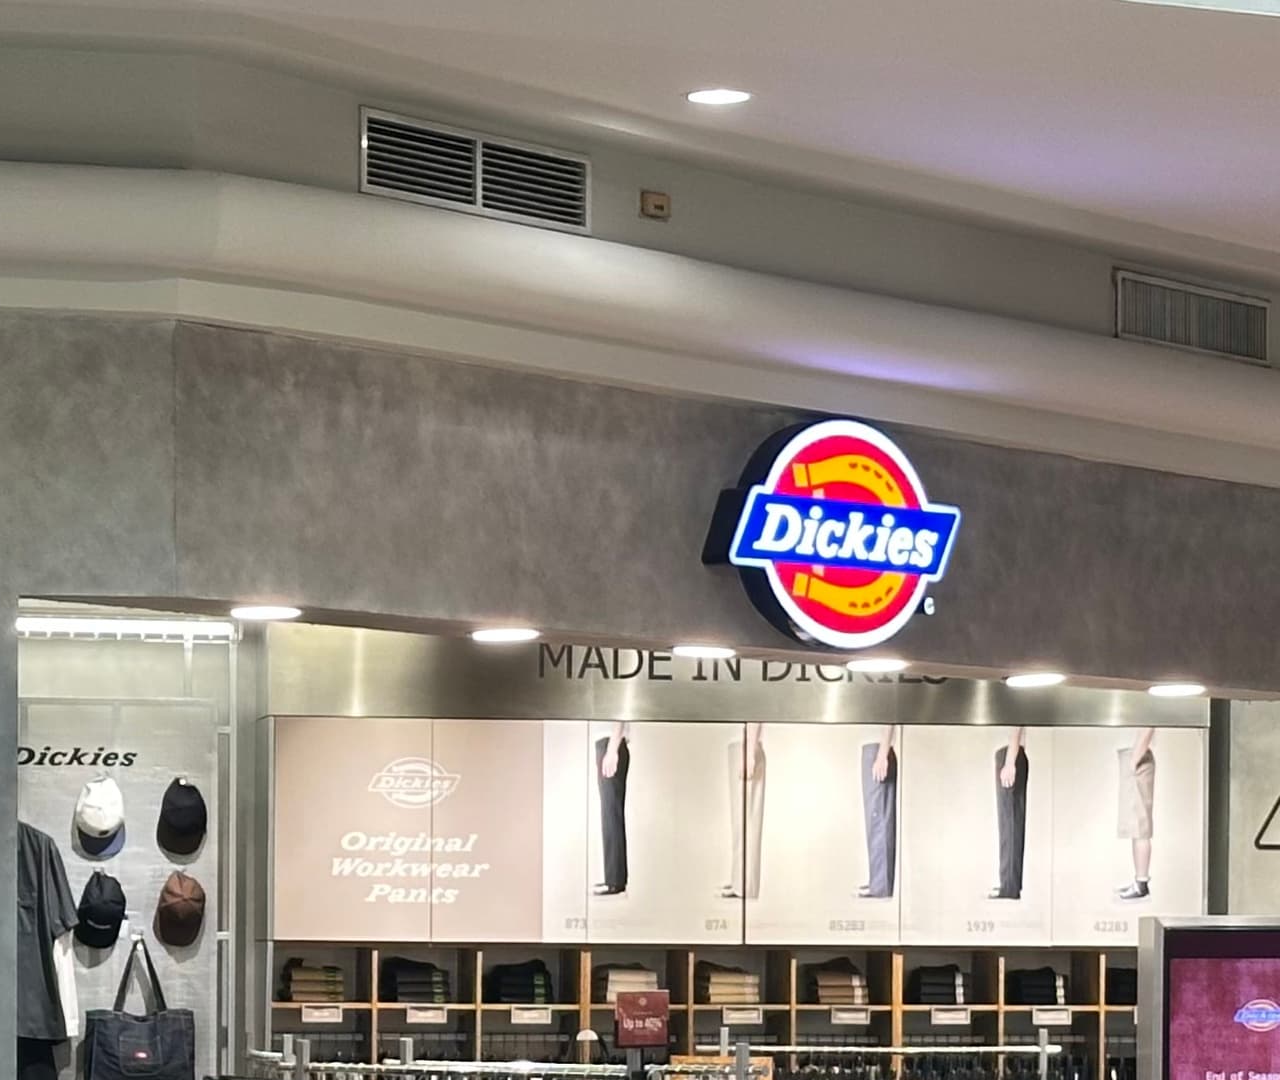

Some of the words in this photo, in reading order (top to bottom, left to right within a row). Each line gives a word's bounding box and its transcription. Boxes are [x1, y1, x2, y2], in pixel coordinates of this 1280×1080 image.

[752, 503, 939, 568] Dickies
[539, 642, 672, 681] MADE
[17, 746, 138, 766] Dickies
[340, 831, 478, 856] Original
[331, 857, 490, 878] Workwear
[364, 884, 459, 903] Pants
